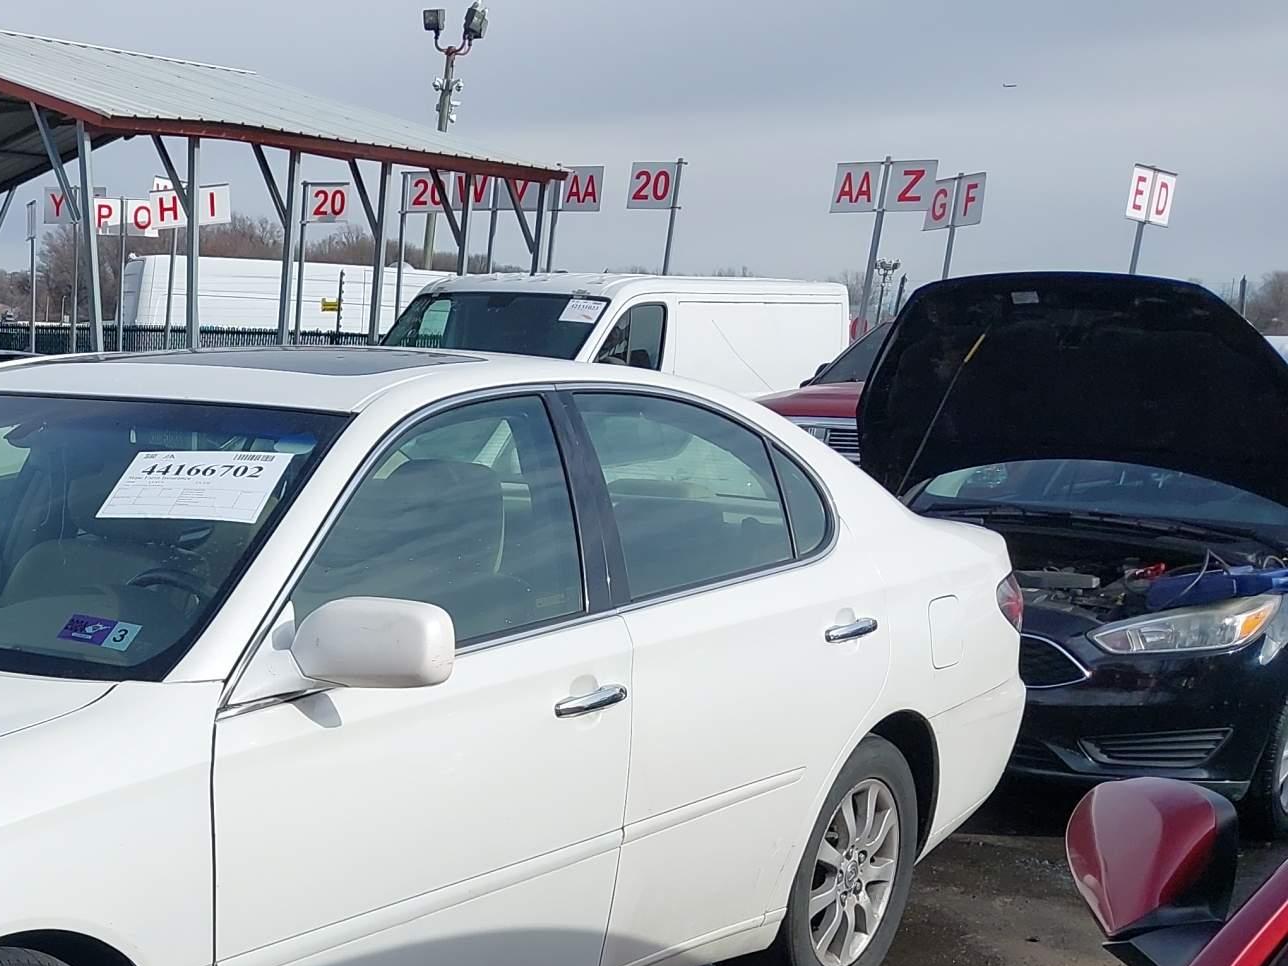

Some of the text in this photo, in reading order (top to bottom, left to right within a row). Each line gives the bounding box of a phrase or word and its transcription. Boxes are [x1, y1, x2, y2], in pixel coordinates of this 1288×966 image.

[412, 179, 446, 206] 20
[566, 175, 596, 203] AA
[632, 170, 670, 201] 20
[836, 171, 872, 203] AA
[897, 169, 925, 202] Z
[1132, 175, 1147, 211] E
[1155, 181, 1169, 215] D
[50, 193, 65, 217] Y
[159, 195, 178, 222] H
[209, 191, 215, 217] I
[312, 189, 346, 216] 20
[931, 188, 948, 221] G
[963, 183, 978, 217] F
[97, 204, 113, 229] P
[134, 205, 151, 230] O
[141, 463, 264, 478] 44166702
[112, 628, 128, 643] 3
